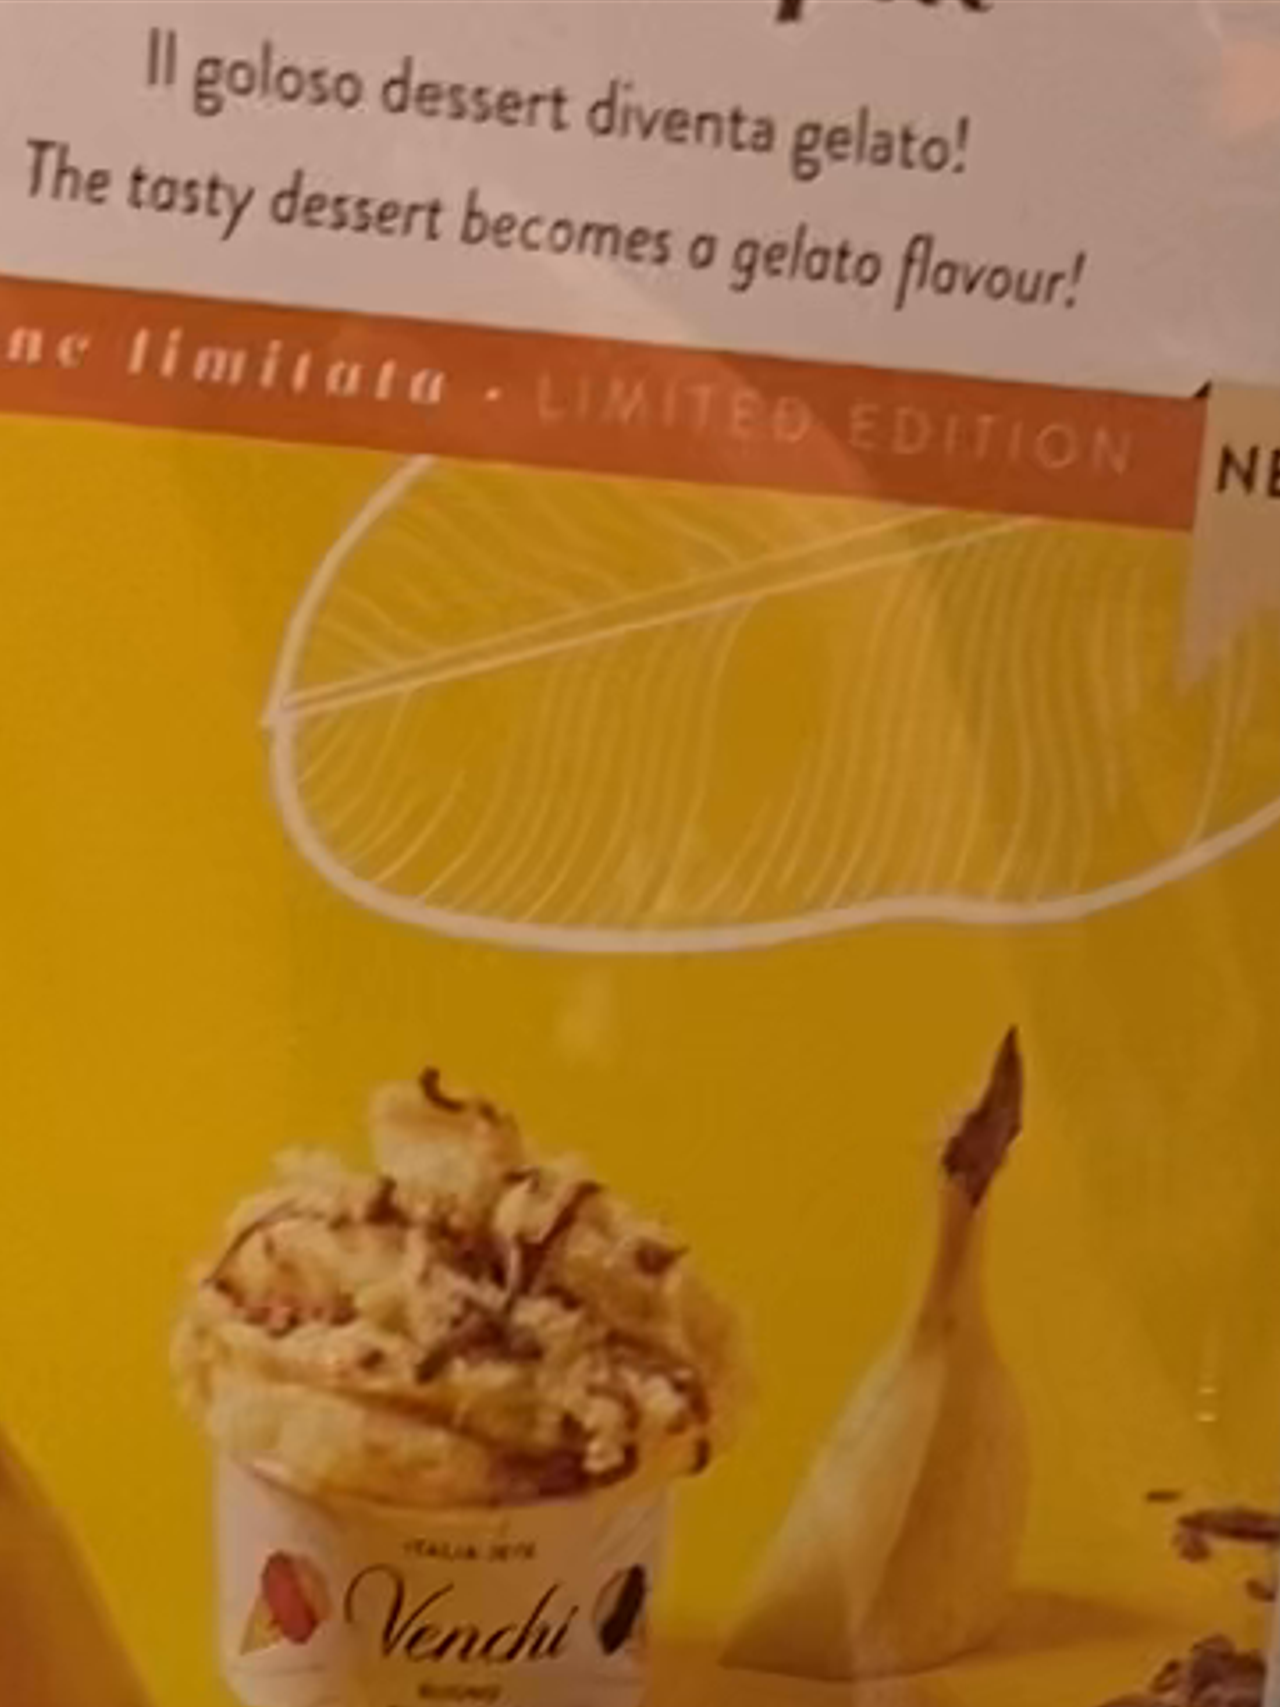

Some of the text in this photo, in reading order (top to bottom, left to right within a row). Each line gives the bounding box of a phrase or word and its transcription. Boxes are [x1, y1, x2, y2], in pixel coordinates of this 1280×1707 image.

[146, 27, 970, 182] Il goloso dessert diventa gelato!
[26, 137, 1086, 312] The tasty dessert becomes a gelato flavour!
[126, 326, 447, 406] limitata
[537, 375, 812, 444] LIMITED
[848, 403, 1132, 473] EDITION
[344, 1563, 579, 1663] Venchi
